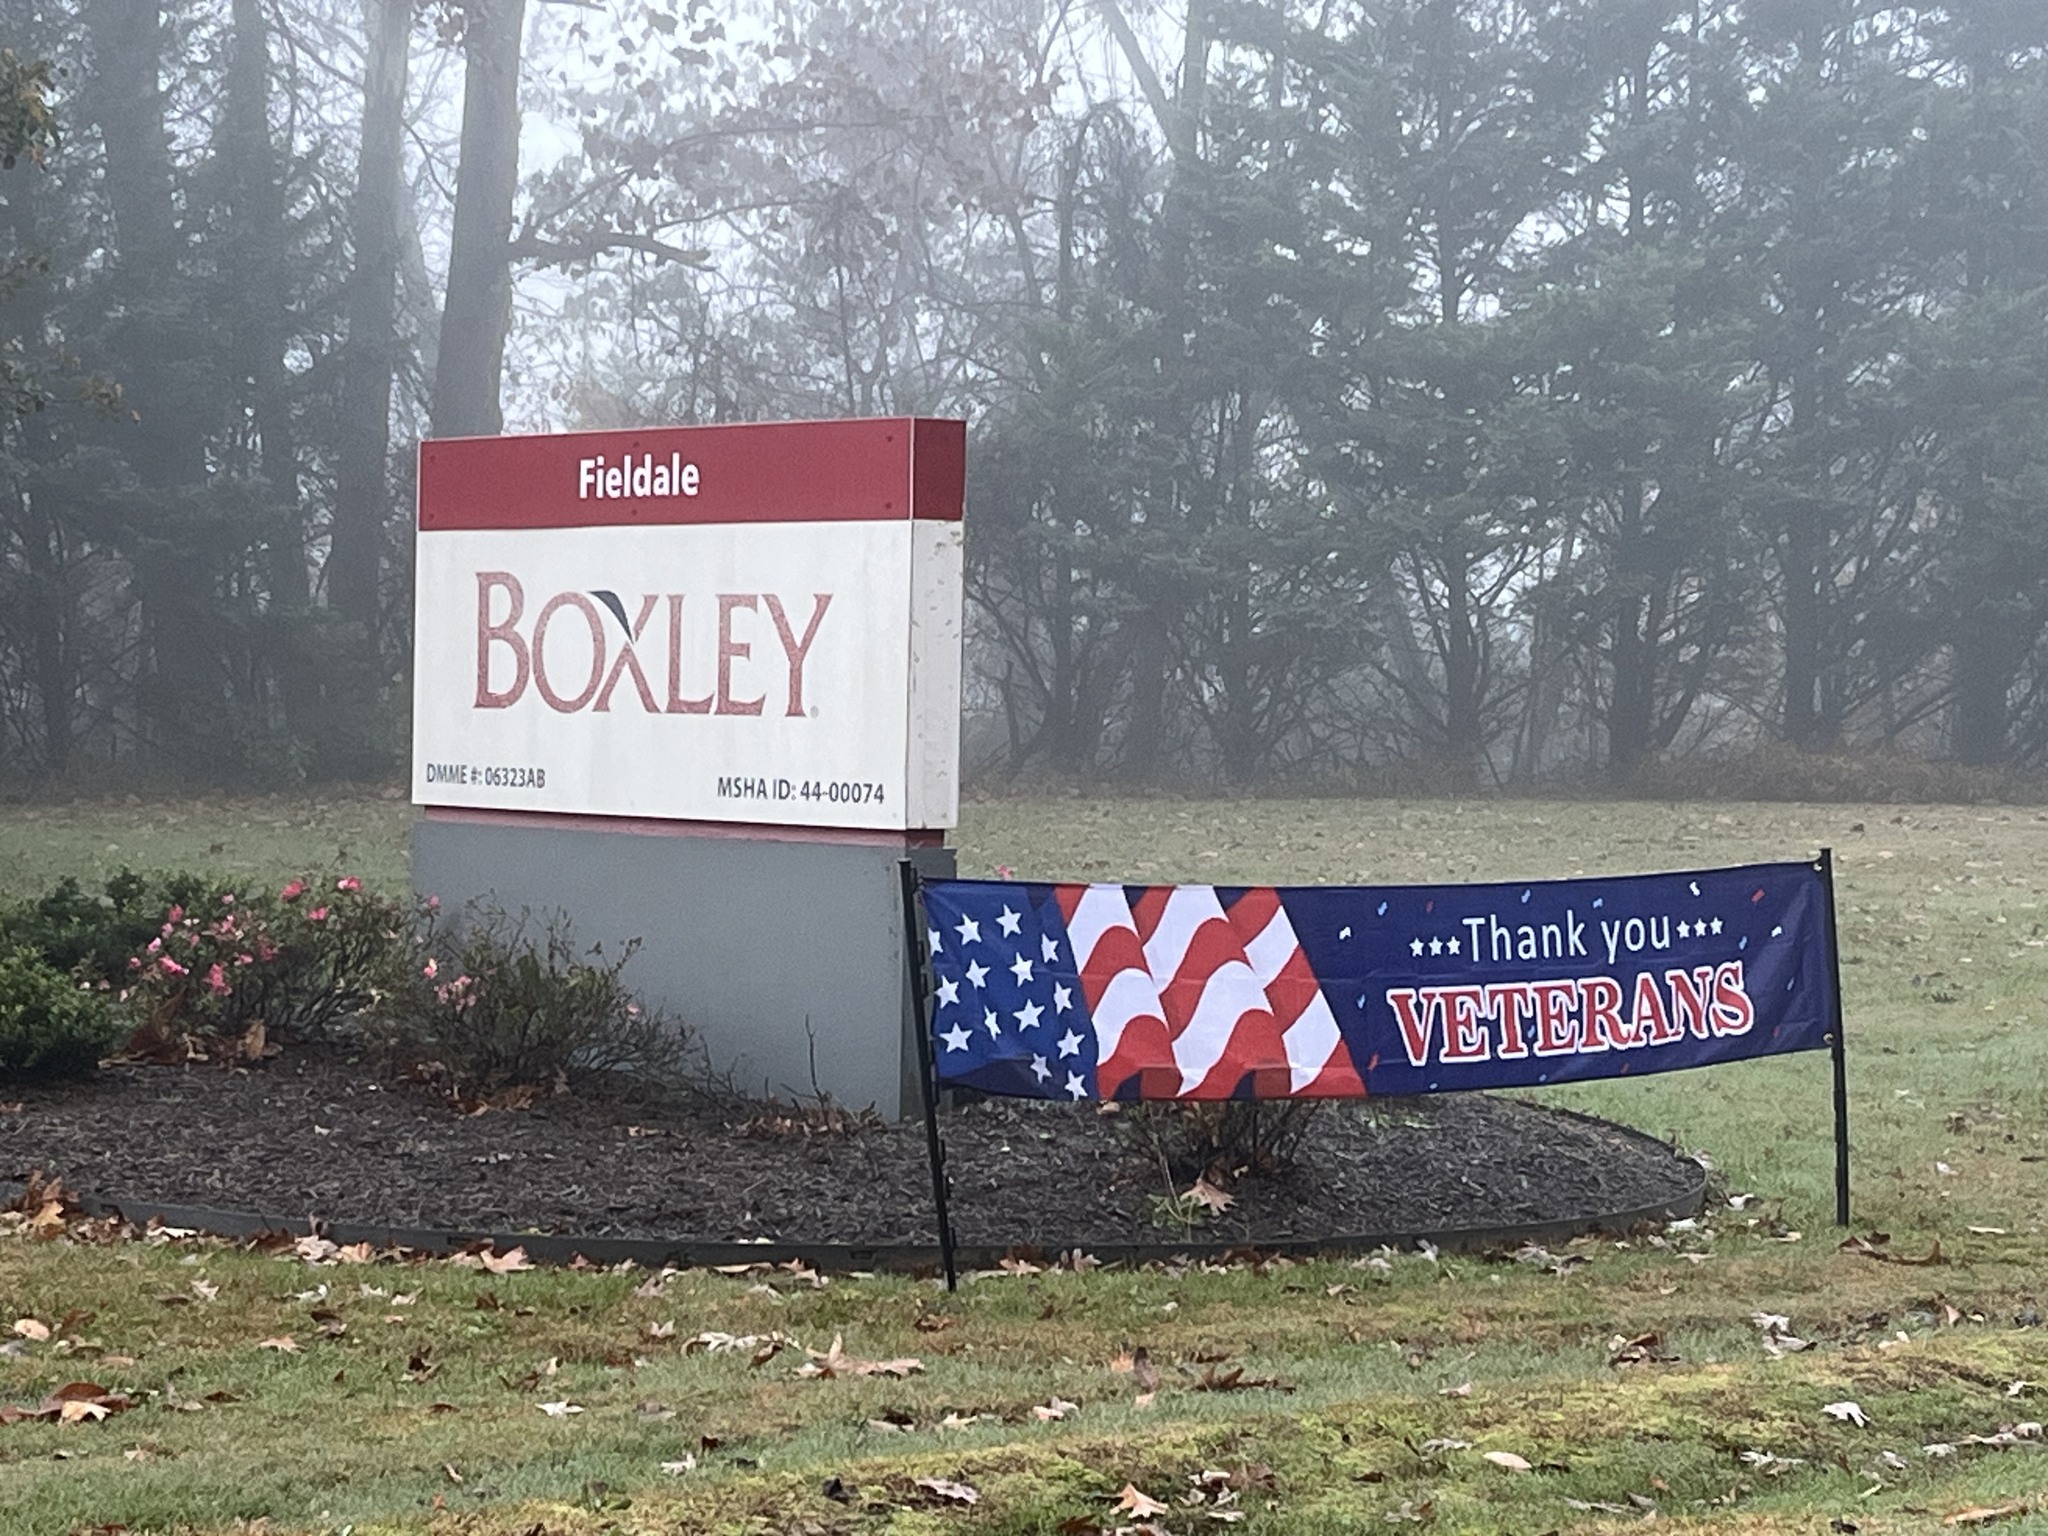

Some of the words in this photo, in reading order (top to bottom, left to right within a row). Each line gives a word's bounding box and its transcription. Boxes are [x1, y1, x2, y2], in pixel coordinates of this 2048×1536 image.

[579, 451, 700, 500] Fieldale
[472, 571, 834, 718] BOXLEY
[426, 763, 467, 785] DMME
[484, 766, 546, 788] 06323AB
[718, 777, 768, 800] MSHA
[772, 778, 797, 801] ID:
[800, 780, 885, 805] 44-00074
[1462, 910, 1588, 962] Thank
[1600, 915, 1671, 964] you
[1387, 960, 1755, 1067] VETERANS
